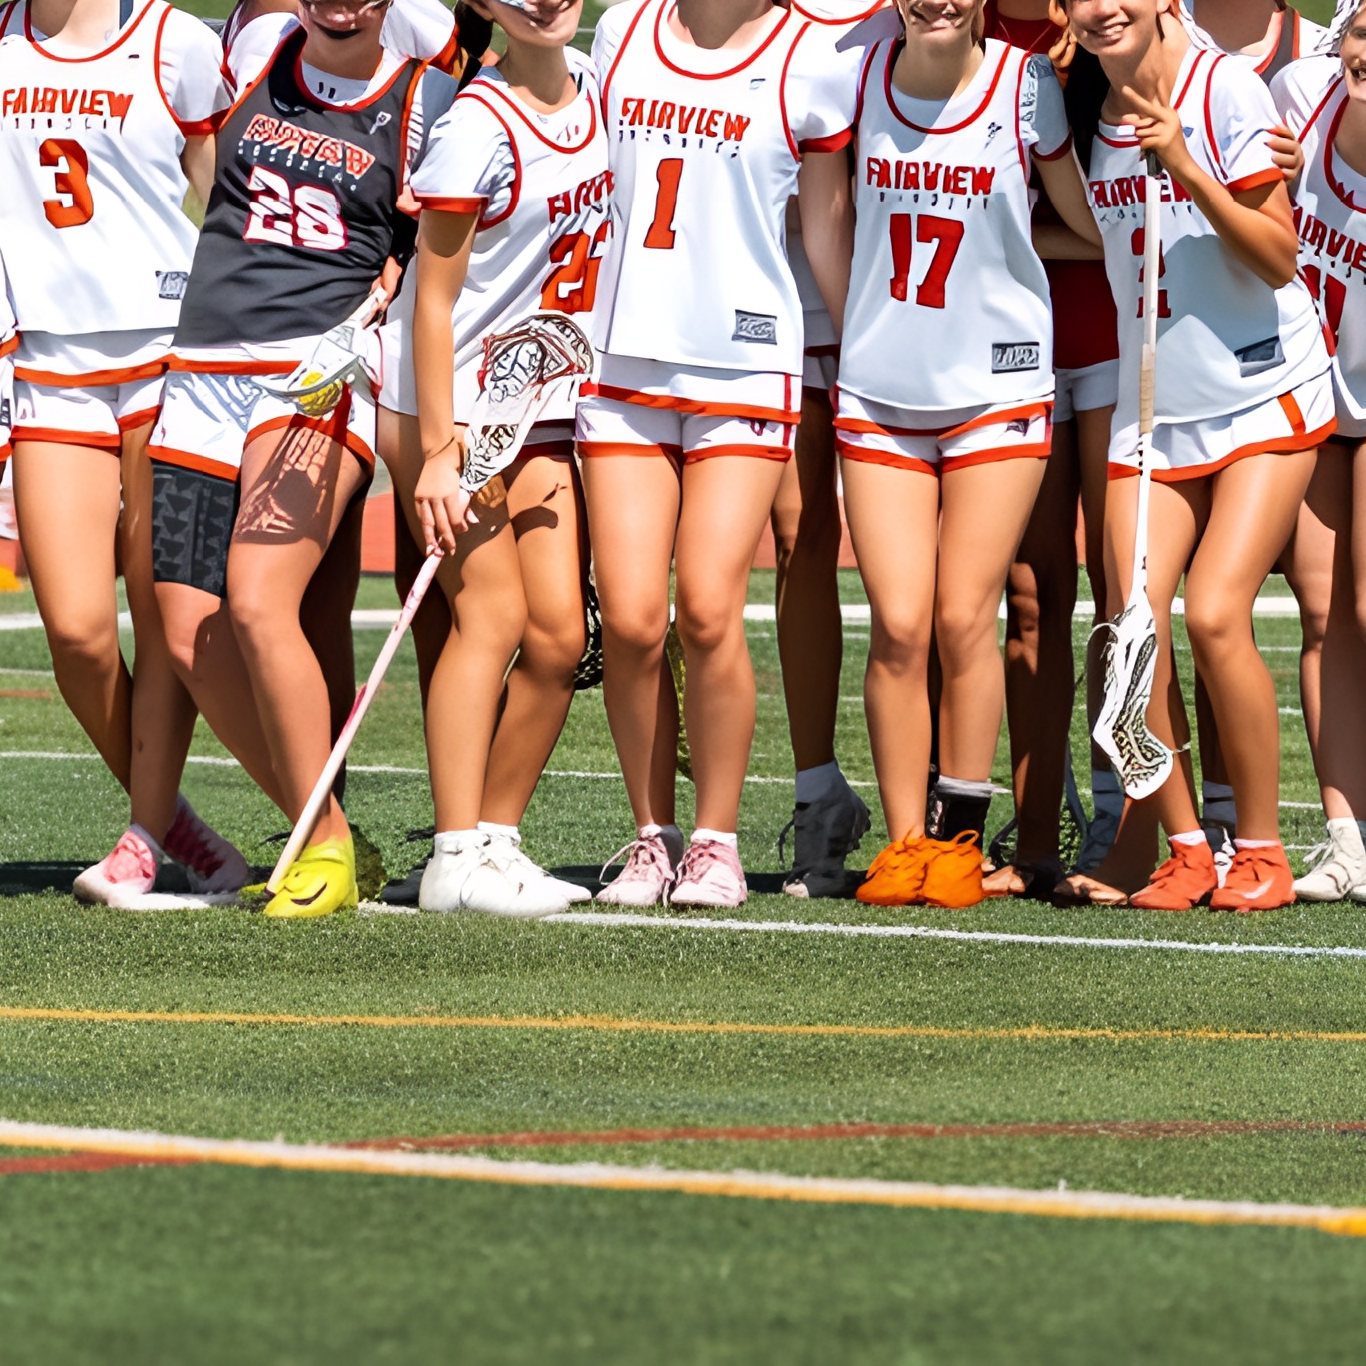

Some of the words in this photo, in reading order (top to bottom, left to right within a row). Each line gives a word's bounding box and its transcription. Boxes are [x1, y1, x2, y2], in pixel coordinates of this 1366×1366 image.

[622, 98, 751, 142] FAIRVIEW
[39, 138, 94, 229] 3
[643, 158, 684, 249] 1
[866, 157, 996, 196] FAIRVIEW
[889, 213, 965, 309] 17
